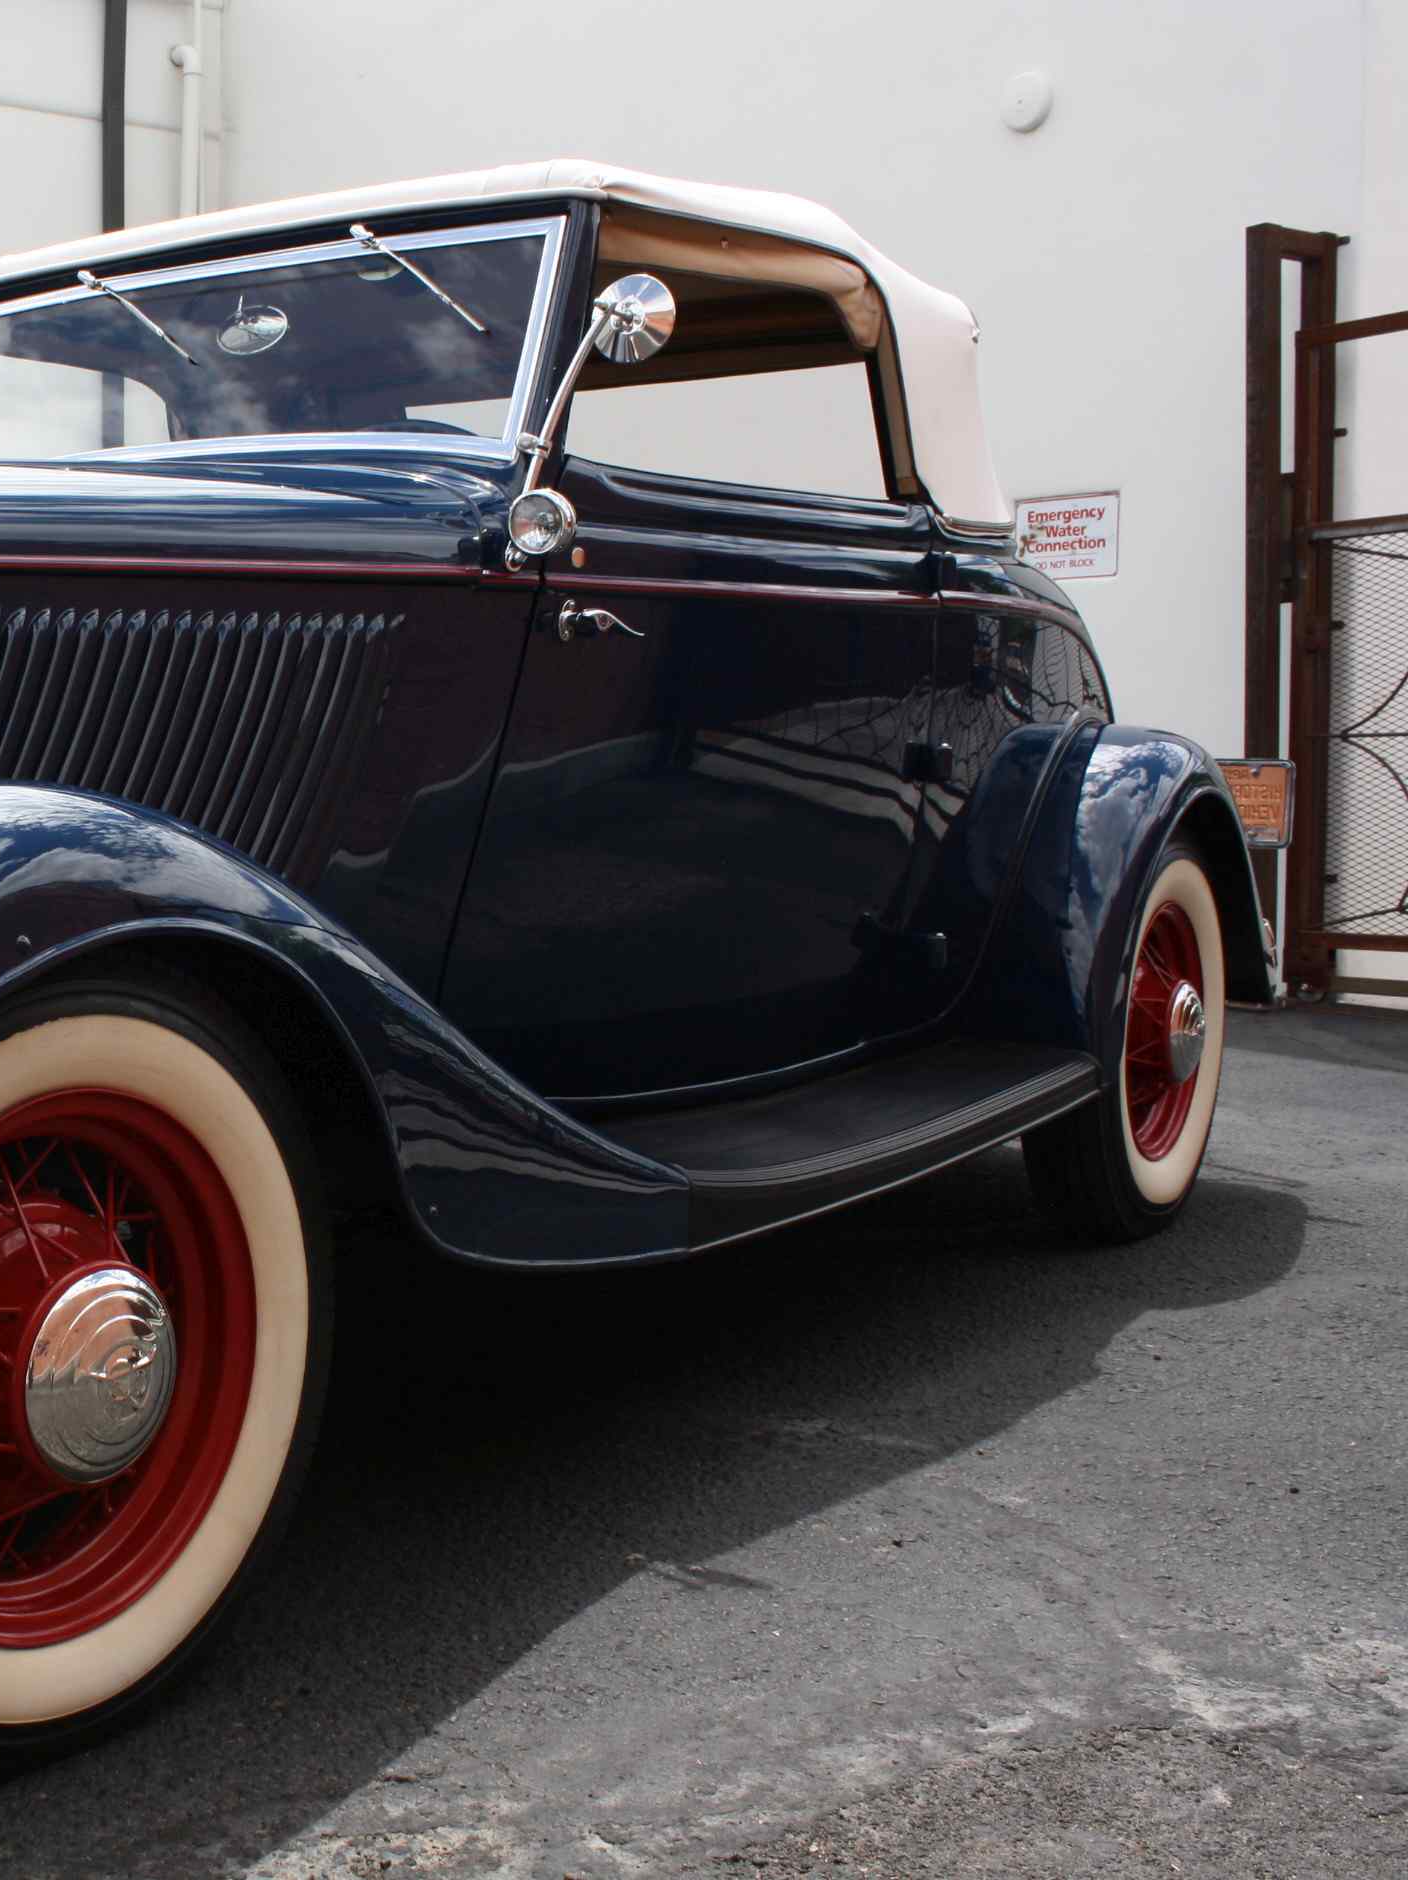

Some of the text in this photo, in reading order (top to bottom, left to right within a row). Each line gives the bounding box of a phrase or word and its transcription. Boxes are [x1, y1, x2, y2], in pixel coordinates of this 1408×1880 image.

[1027, 506, 1105, 523] Emergency
[1045, 525, 1087, 538] Water
[1026, 537, 1106, 553] Connection
[1035, 559, 1094, 570] DO NOT BLOCK
